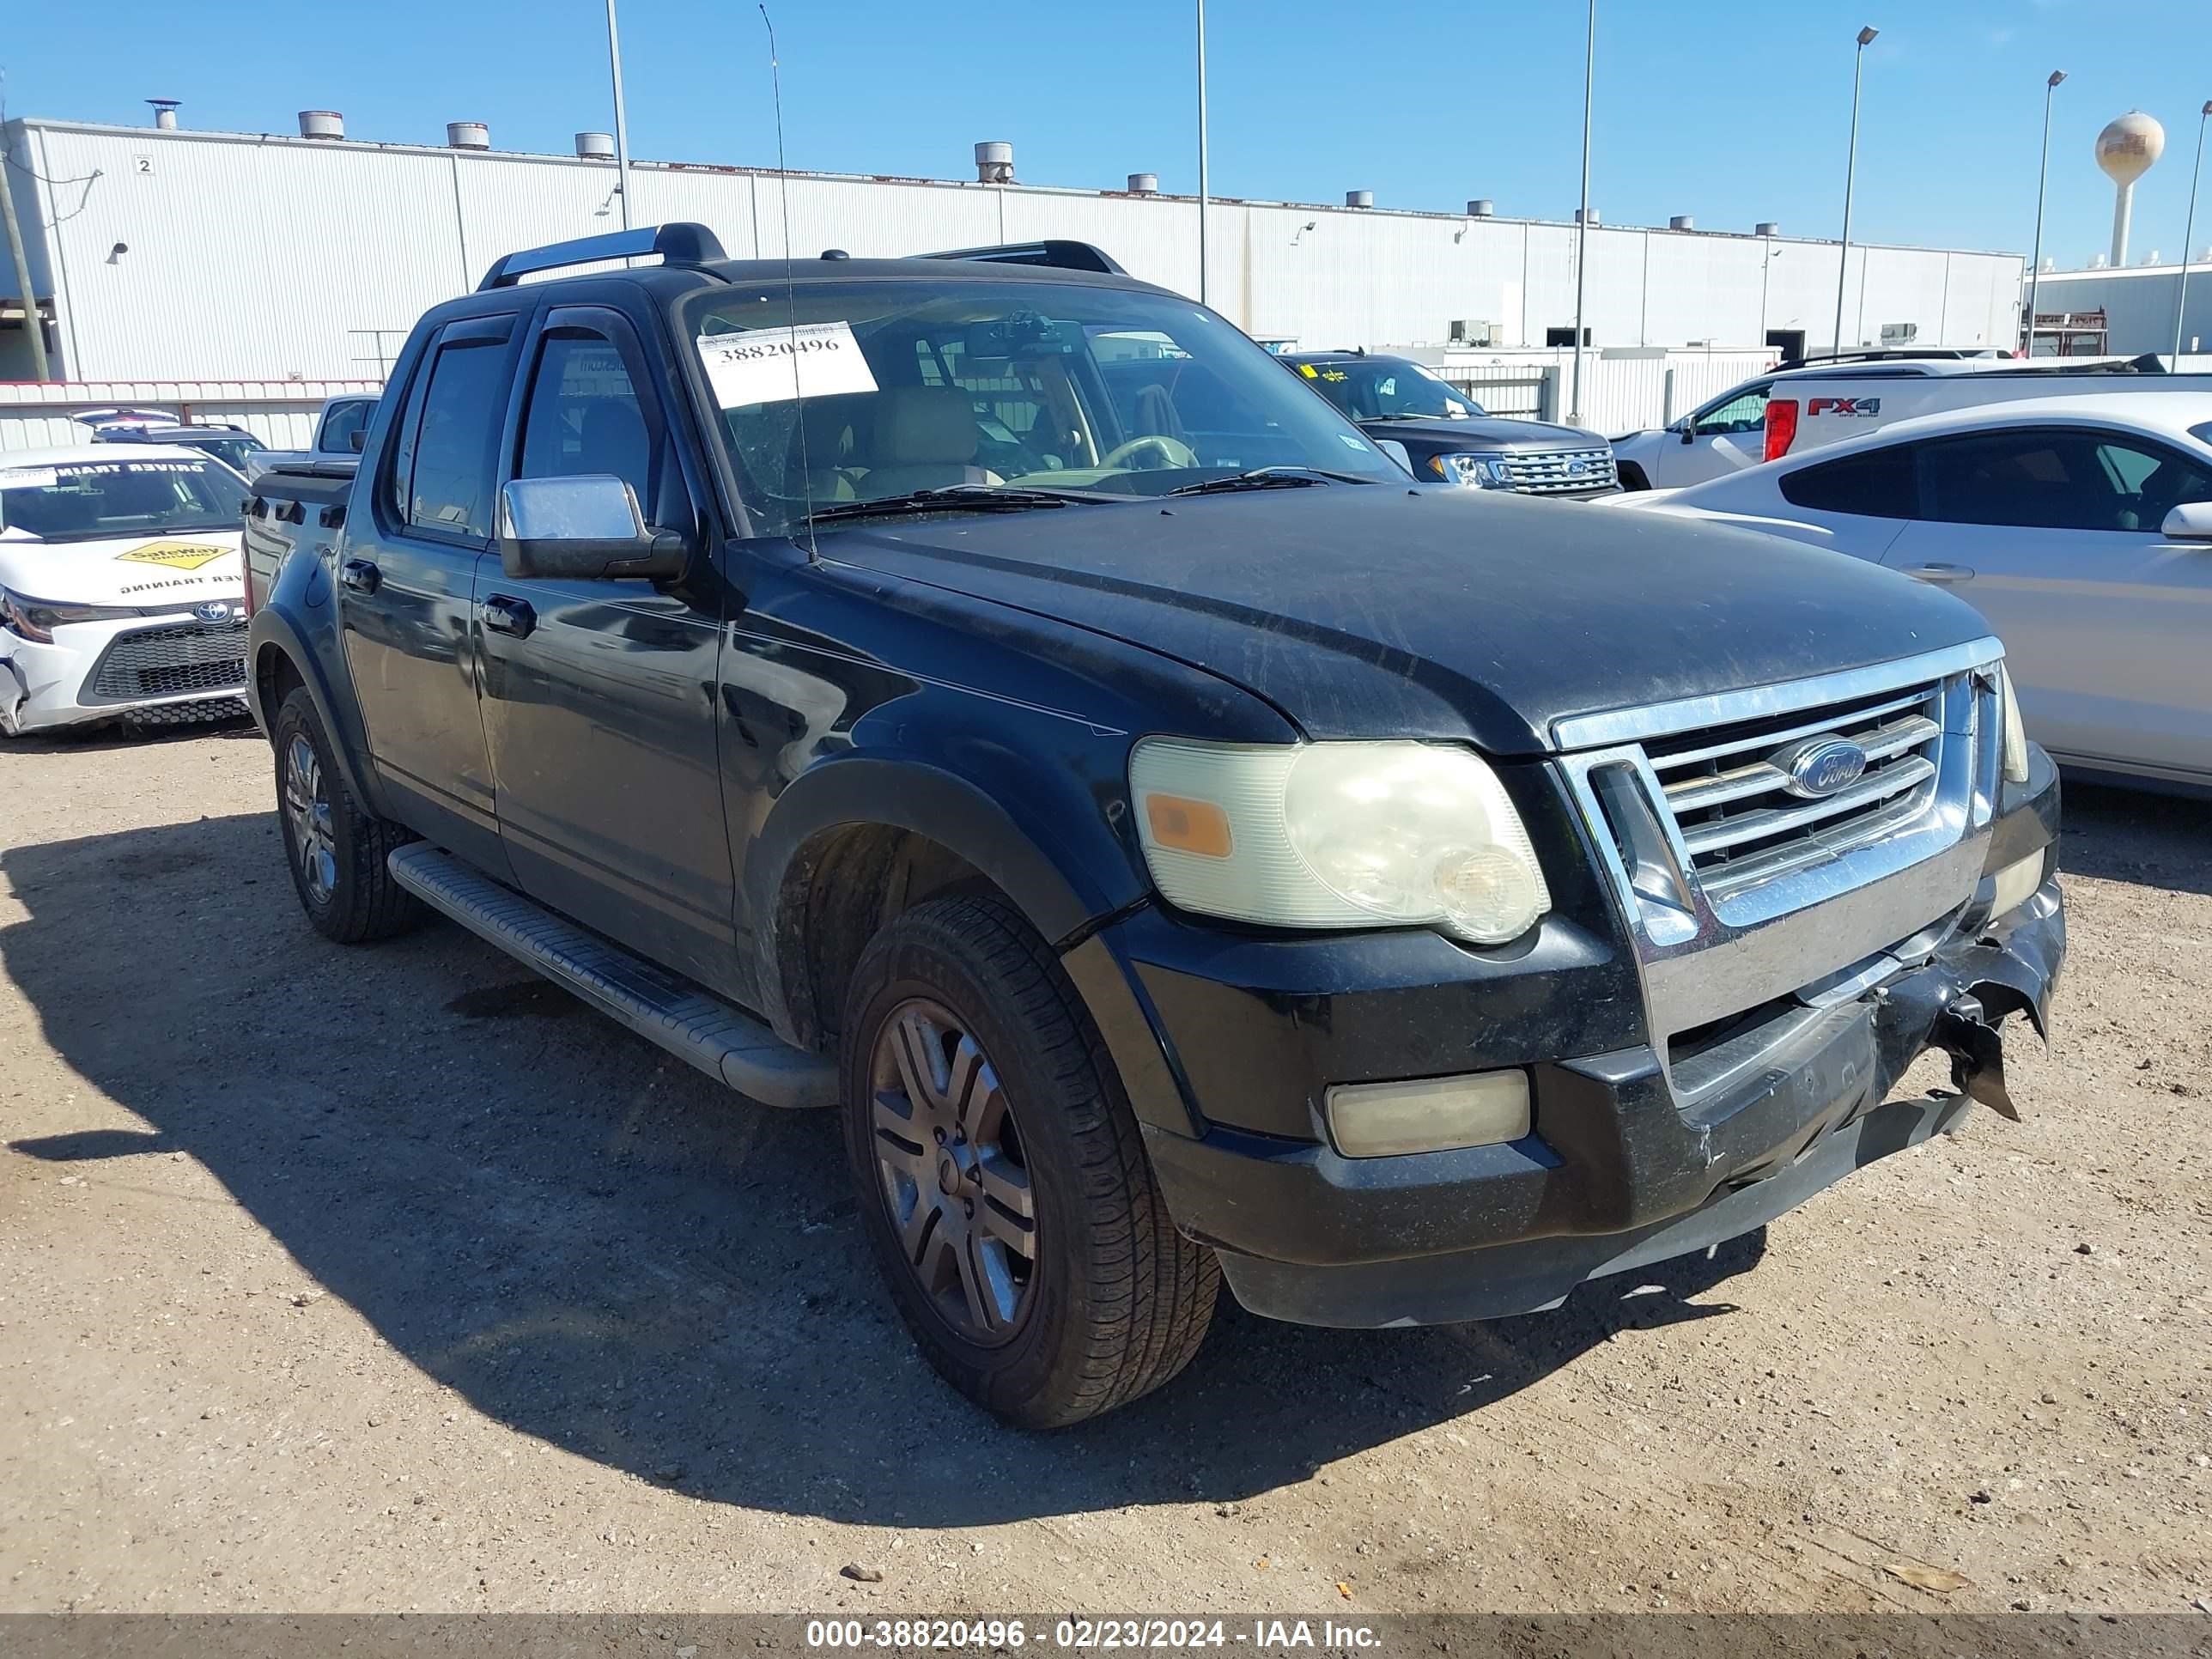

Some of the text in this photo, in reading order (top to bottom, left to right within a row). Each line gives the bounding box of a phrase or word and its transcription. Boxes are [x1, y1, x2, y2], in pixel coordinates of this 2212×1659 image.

[139, 160, 151, 172] 2
[719, 337, 840, 364] 38820496
[1807, 398, 1881, 416] FX4
[131, 547, 219, 559] SafeWay
[150, 552, 211, 561] DRIVING
[1817, 750, 1862, 787] Ford
